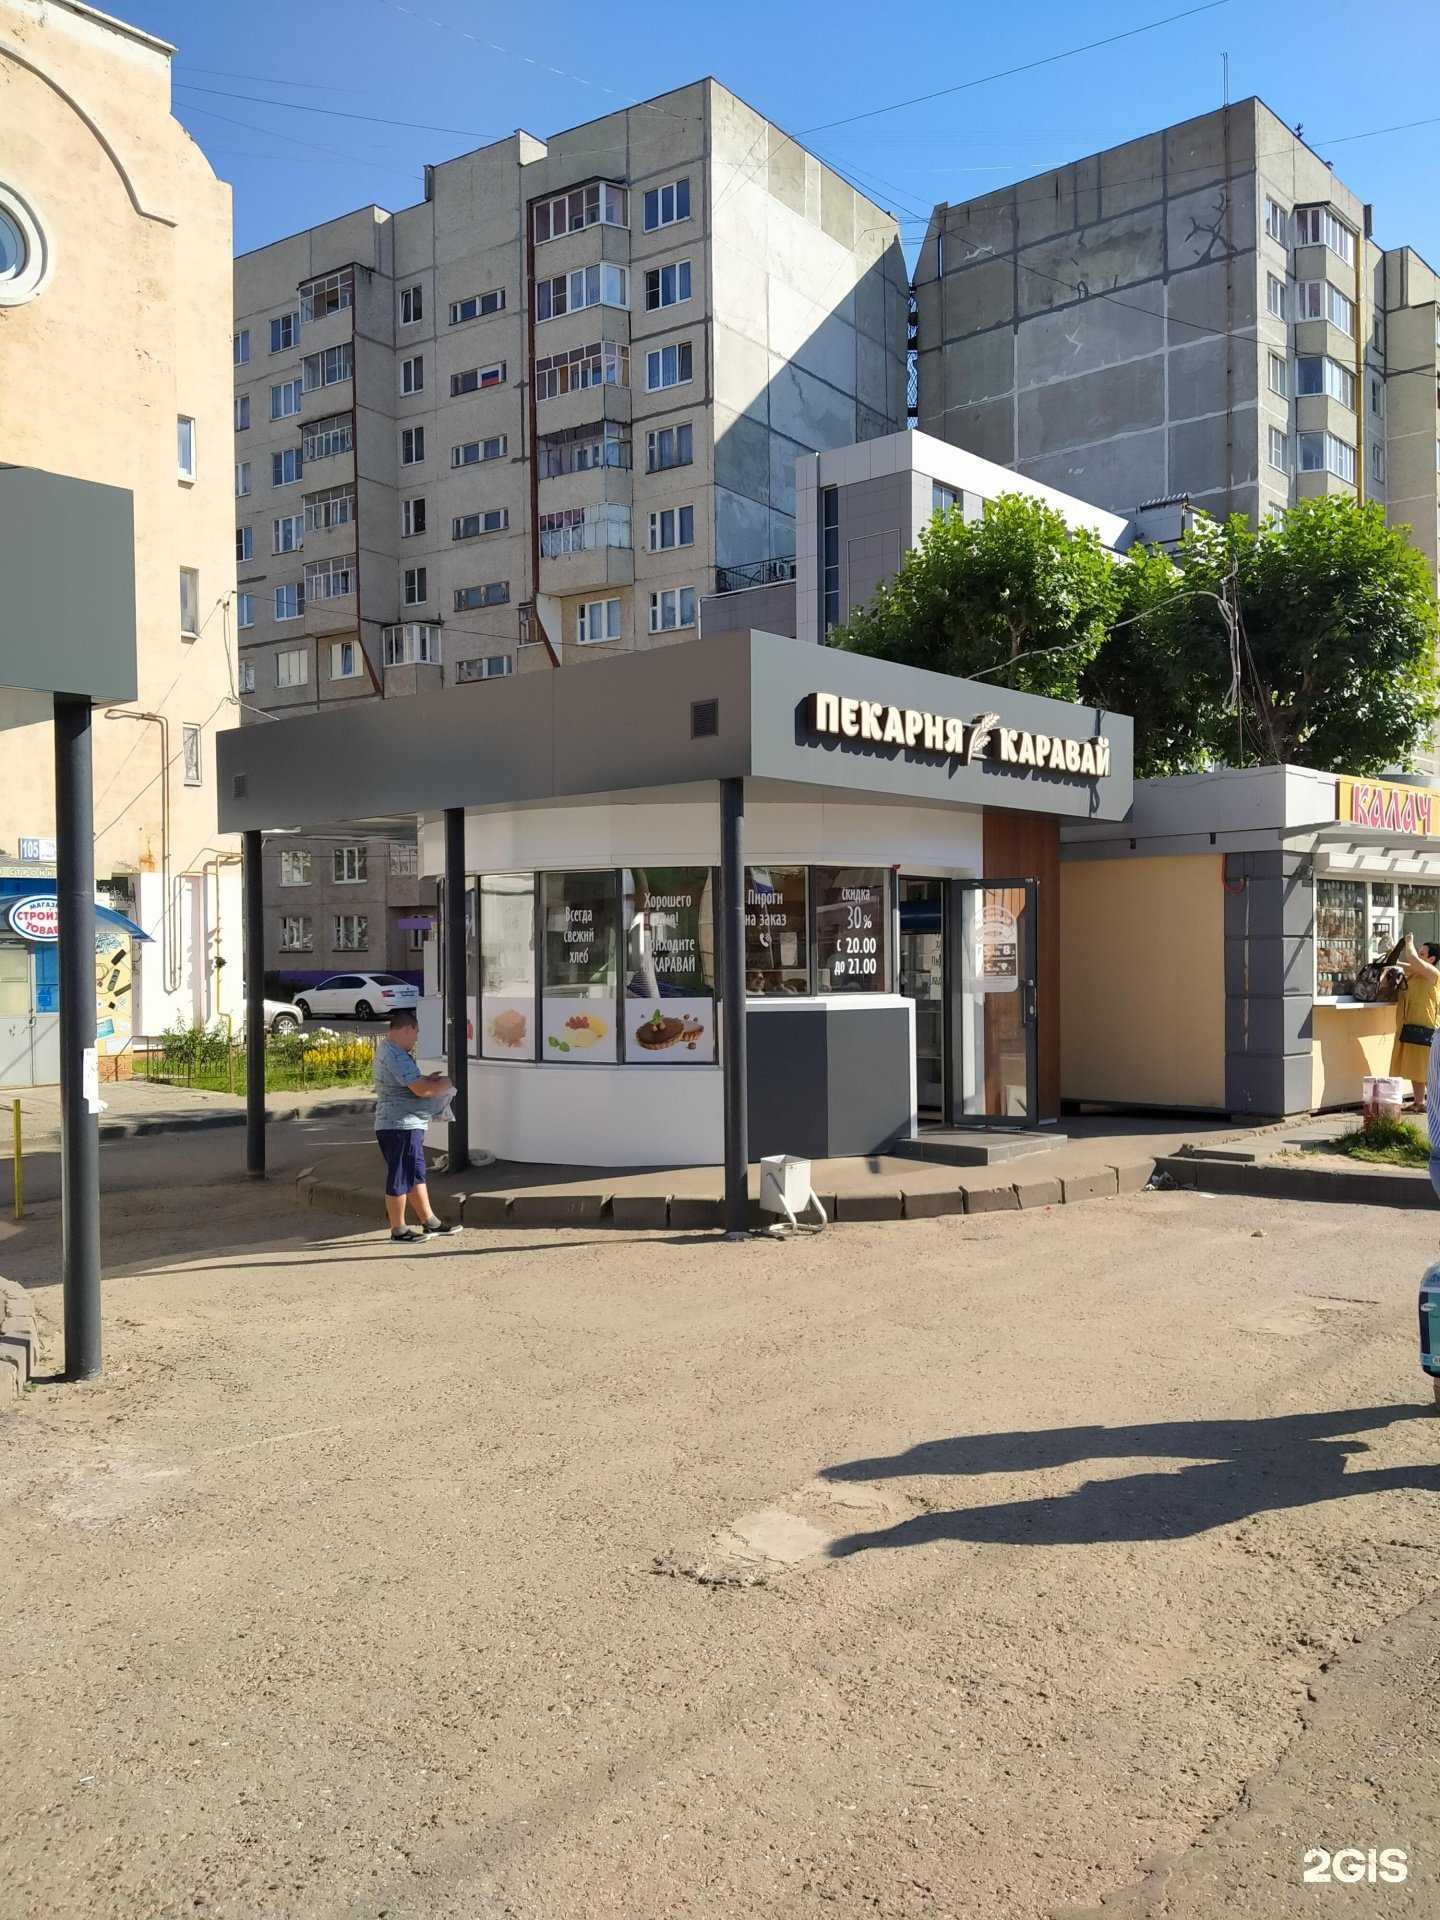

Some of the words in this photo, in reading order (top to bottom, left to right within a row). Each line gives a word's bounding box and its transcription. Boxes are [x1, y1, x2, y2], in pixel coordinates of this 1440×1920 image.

[815, 692, 964, 755] ПЕКАРНЯ
[1000, 726, 1111, 777] КАРАВАЙ
[30, 901, 58, 910] МАГАЗ
[643, 892, 692, 911] Хорошего
[747, 888, 784, 909] Пироги
[565, 906, 593, 924] Всегда
[745, 913, 757, 926] на
[759, 913, 787, 927] заказ
[847, 905, 862, 929] 30
[563, 927, 595, 943] свежий
[846, 937, 877, 954] 20.00
[569, 946, 589, 964] хлеб
[834, 960, 846, 976] до
[848, 958, 877, 975] 21.00
